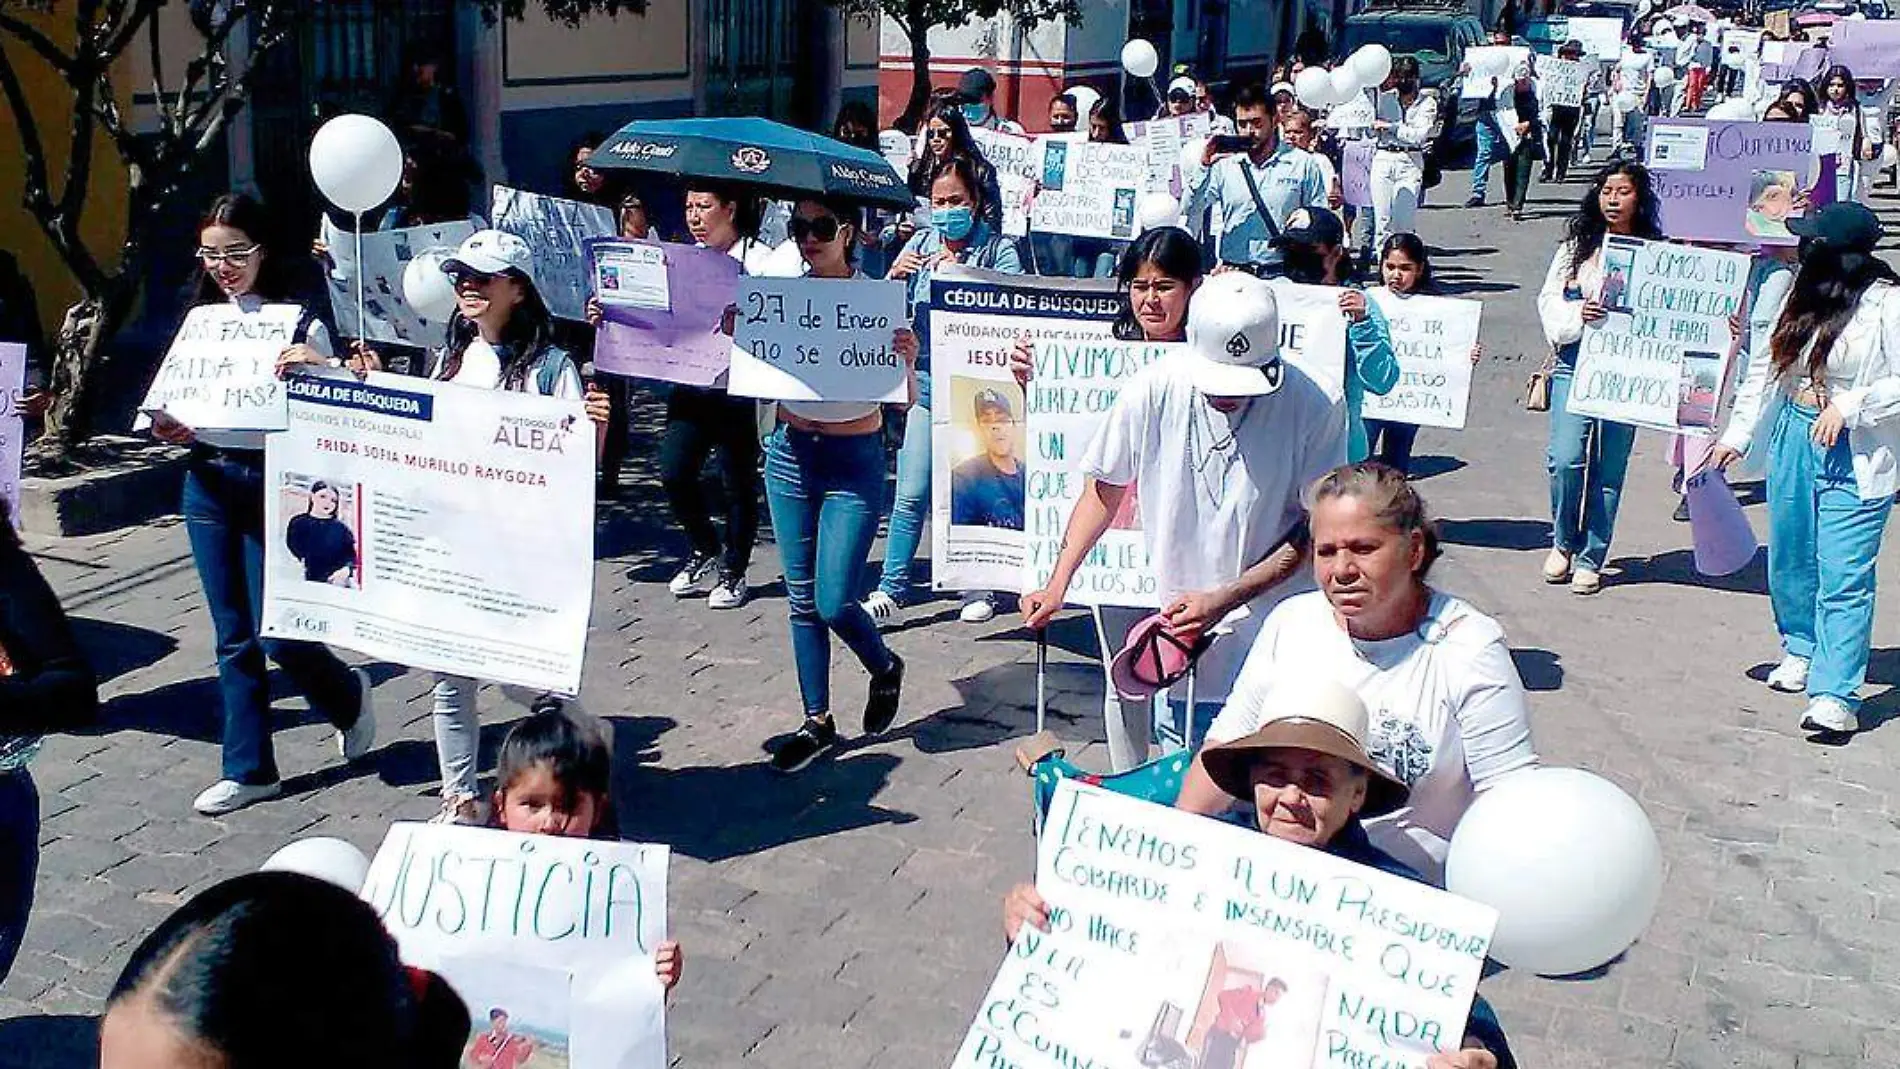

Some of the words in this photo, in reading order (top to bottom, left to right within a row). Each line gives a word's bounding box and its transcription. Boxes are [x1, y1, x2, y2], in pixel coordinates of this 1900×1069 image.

[1645, 242, 1706, 282] SOMOS
[1715, 259, 1737, 285] LA
[746, 291, 785, 325] 27
[799, 299, 822, 331] de
[836, 304, 889, 331] Enero
[944, 288, 1009, 309] CÉDULA
[1013, 294, 1036, 310] DE
[220, 320, 288, 342] FALTA
[751, 338, 783, 360] no
[795, 344, 820, 365] se
[1033, 343, 1137, 380] VIVIMOS
[332, 388, 352, 403] DE
[352, 389, 420, 415] BÚSQUEDA
[1028, 380, 1081, 415] JEREZ
[493, 425, 564, 455] ALBA
[1038, 430, 1065, 461] UN
[316, 438, 359, 455] FRIDA
[364, 445, 400, 463] SOFIA
[404, 454, 469, 475] MURILLO
[475, 465, 548, 487] RAYGOZA
[1028, 470, 1072, 501] QUE
[1035, 506, 1060, 538] LA
[1092, 572, 1125, 595] LOS
[1065, 787, 1199, 870] TENEMOS
[1271, 871, 1319, 905] UN
[1053, 846, 1170, 904] COBARDE
[1225, 899, 1354, 962] INSENSIBLE
[1380, 943, 1460, 999] QUE
[1019, 971, 1061, 1009] ES
[1339, 992, 1443, 1054] NADA
